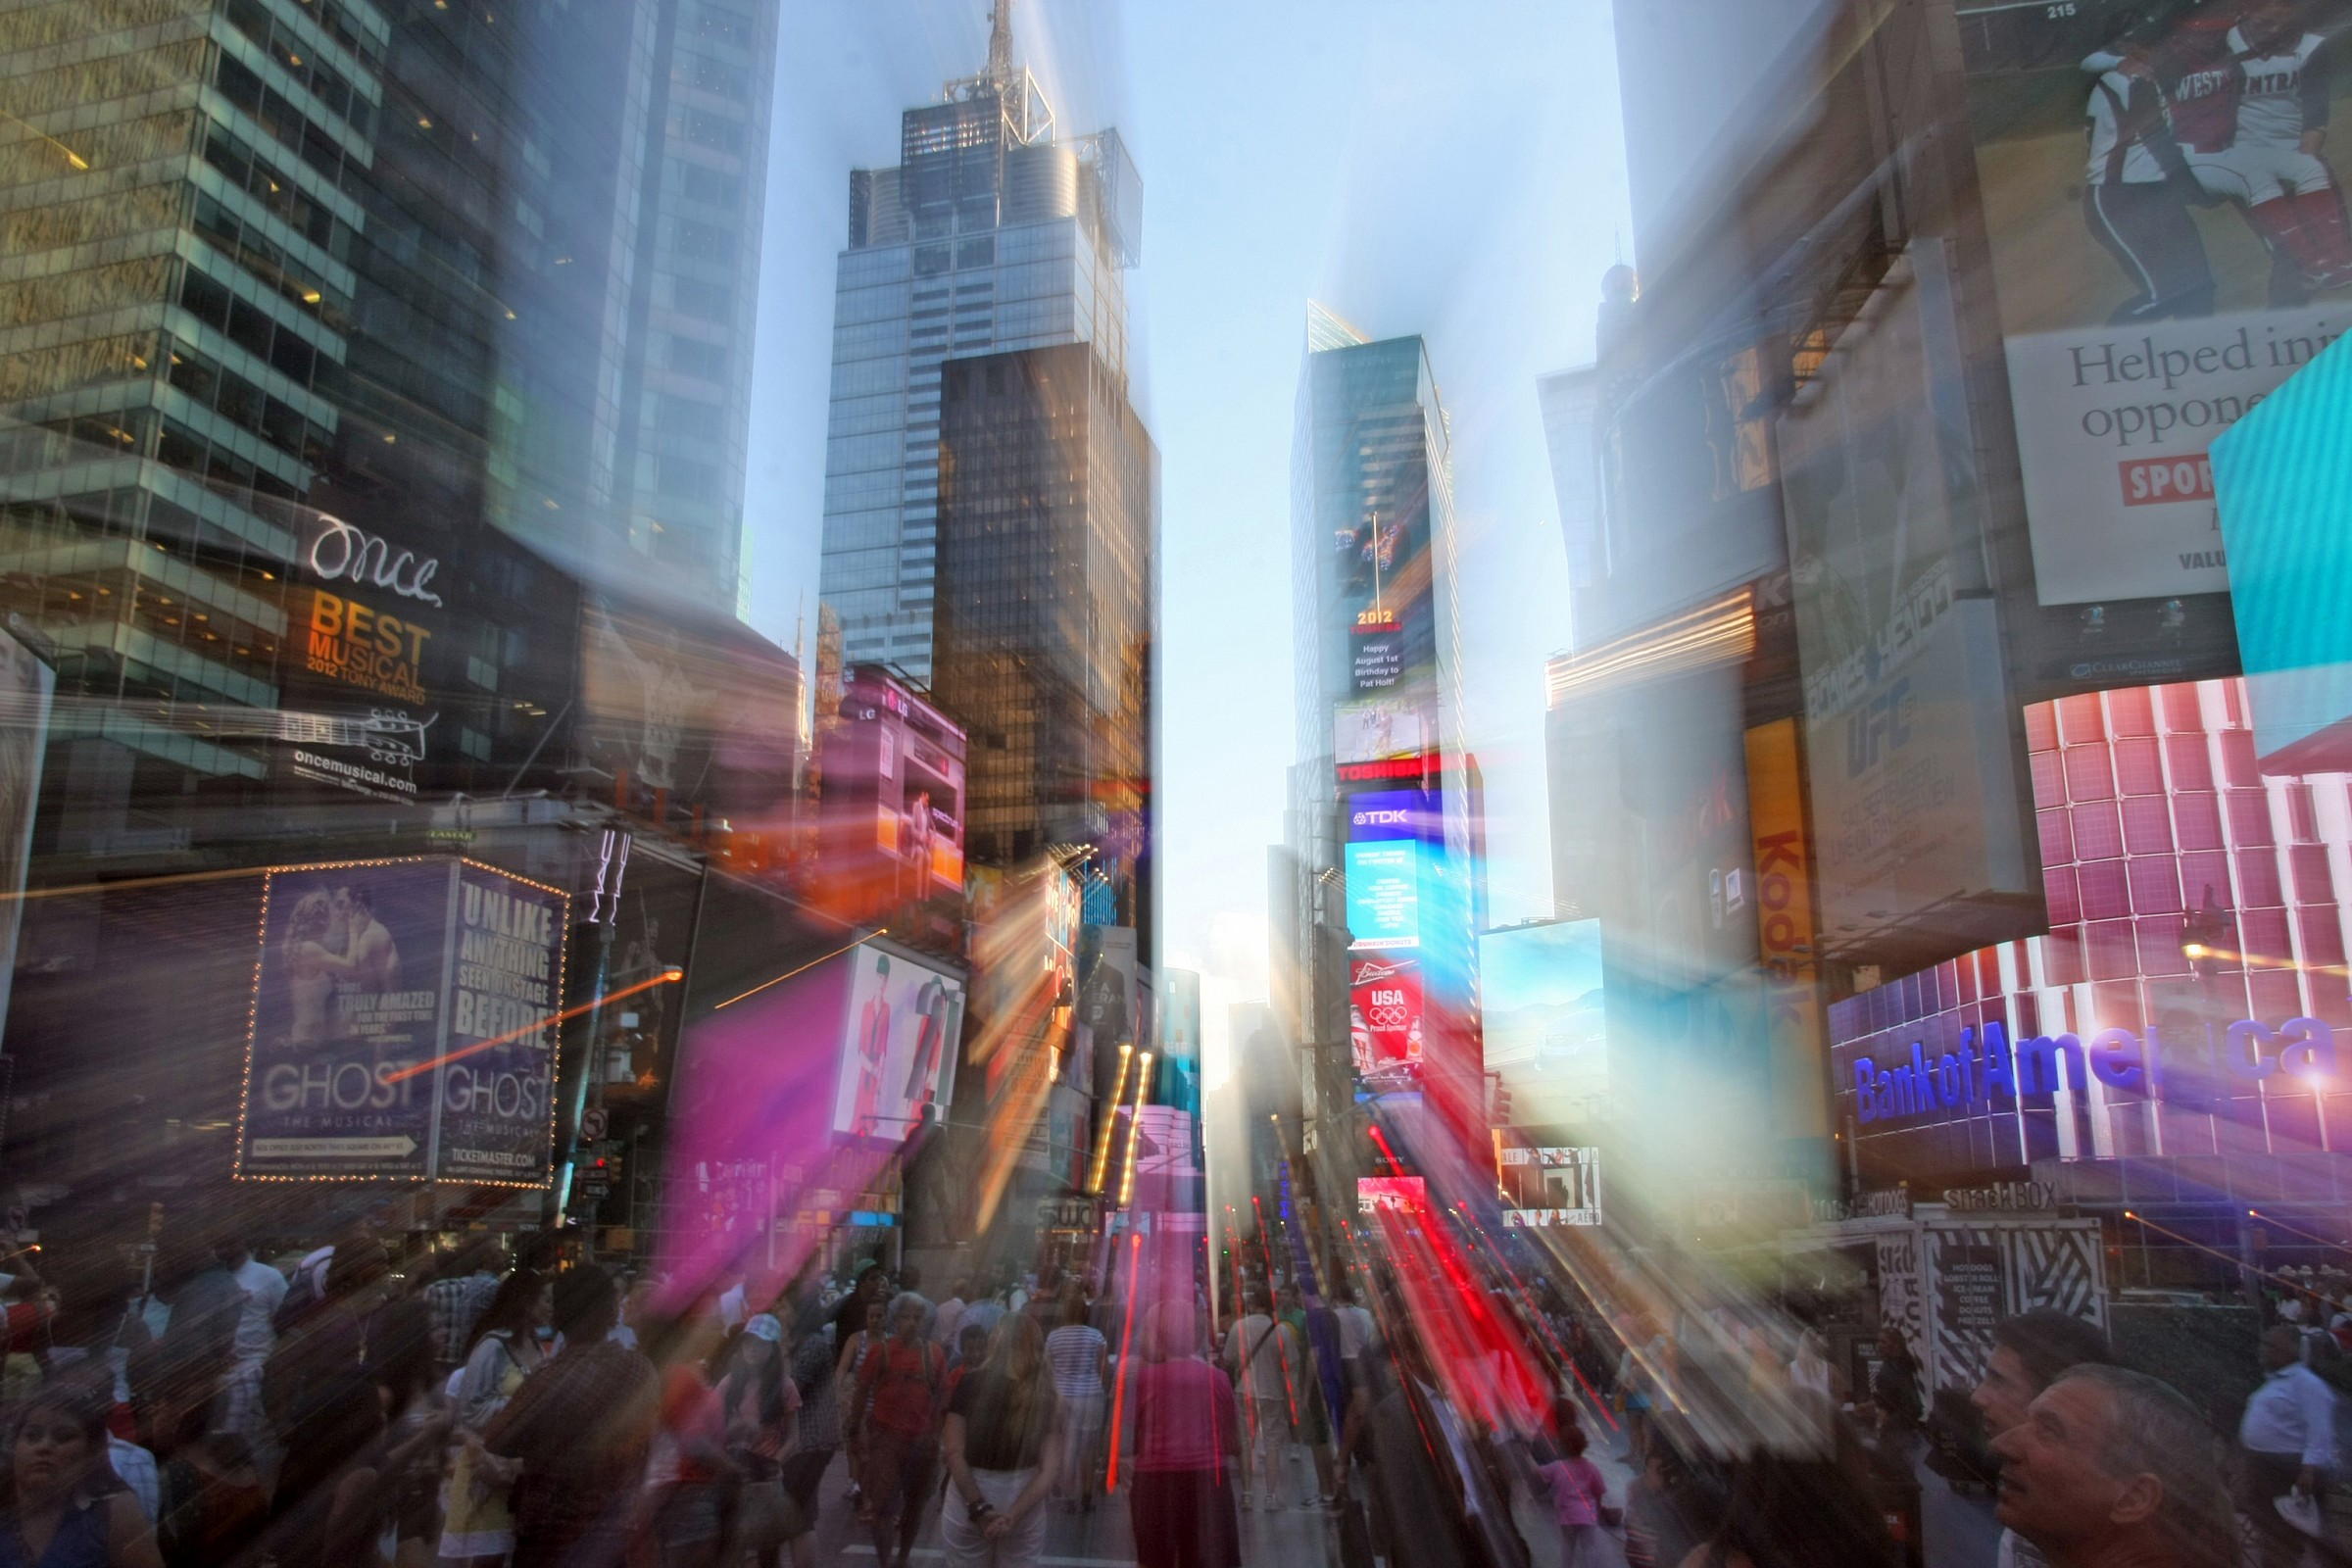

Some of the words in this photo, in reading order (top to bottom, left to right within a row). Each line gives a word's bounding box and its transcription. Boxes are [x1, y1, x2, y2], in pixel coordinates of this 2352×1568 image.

[2047, 5, 2077, 19] 215
[2175, 70, 2225, 103] WEST
[2068, 326, 2255, 391] Helped
[2178, 550, 2227, 570] VALU
[311, 589, 431, 665] BEST
[1349, 621, 1403, 635] TOSHIBA
[1357, 611, 1393, 625] 2012
[1363, 644, 1389, 654] Happy
[308, 629, 425, 694] MUSICAL
[1355, 657, 1384, 666] August
[1386, 655, 1398, 663] 1st
[307, 657, 338, 678] 2012
[340, 667, 378, 690] TONY
[378, 680, 426, 706] AWARD
[1354, 667, 1389, 677] Birthday
[1375, 678, 1396, 687] Holt!
[858, 709, 876, 720] LG
[898, 699, 908, 717] LG
[1846, 676, 1911, 779] UFC
[294, 750, 417, 794] oncemusical.com
[1337, 760, 1422, 781] TOSHIBA
[1365, 809, 1408, 824] TDK
[461, 929, 550, 981] ANYTHING
[459, 965, 490, 992] SEEN
[338, 994, 378, 1013] TRULY
[378, 991, 434, 1012] AMAZED
[1371, 990, 1404, 1005] USA
[264, 1060, 419, 1110] GHOST
[1854, 1042, 1937, 1124] Bank
[1937, 1026, 1976, 1109] of
[444, 1064, 551, 1119] GHOST
[283, 1116, 314, 1127] THE
[321, 1116, 393, 1128] MUSICAL
[452, 1148, 536, 1167] TICKETMASTER.COM
[1970, 1263, 1993, 1272] DOGS
